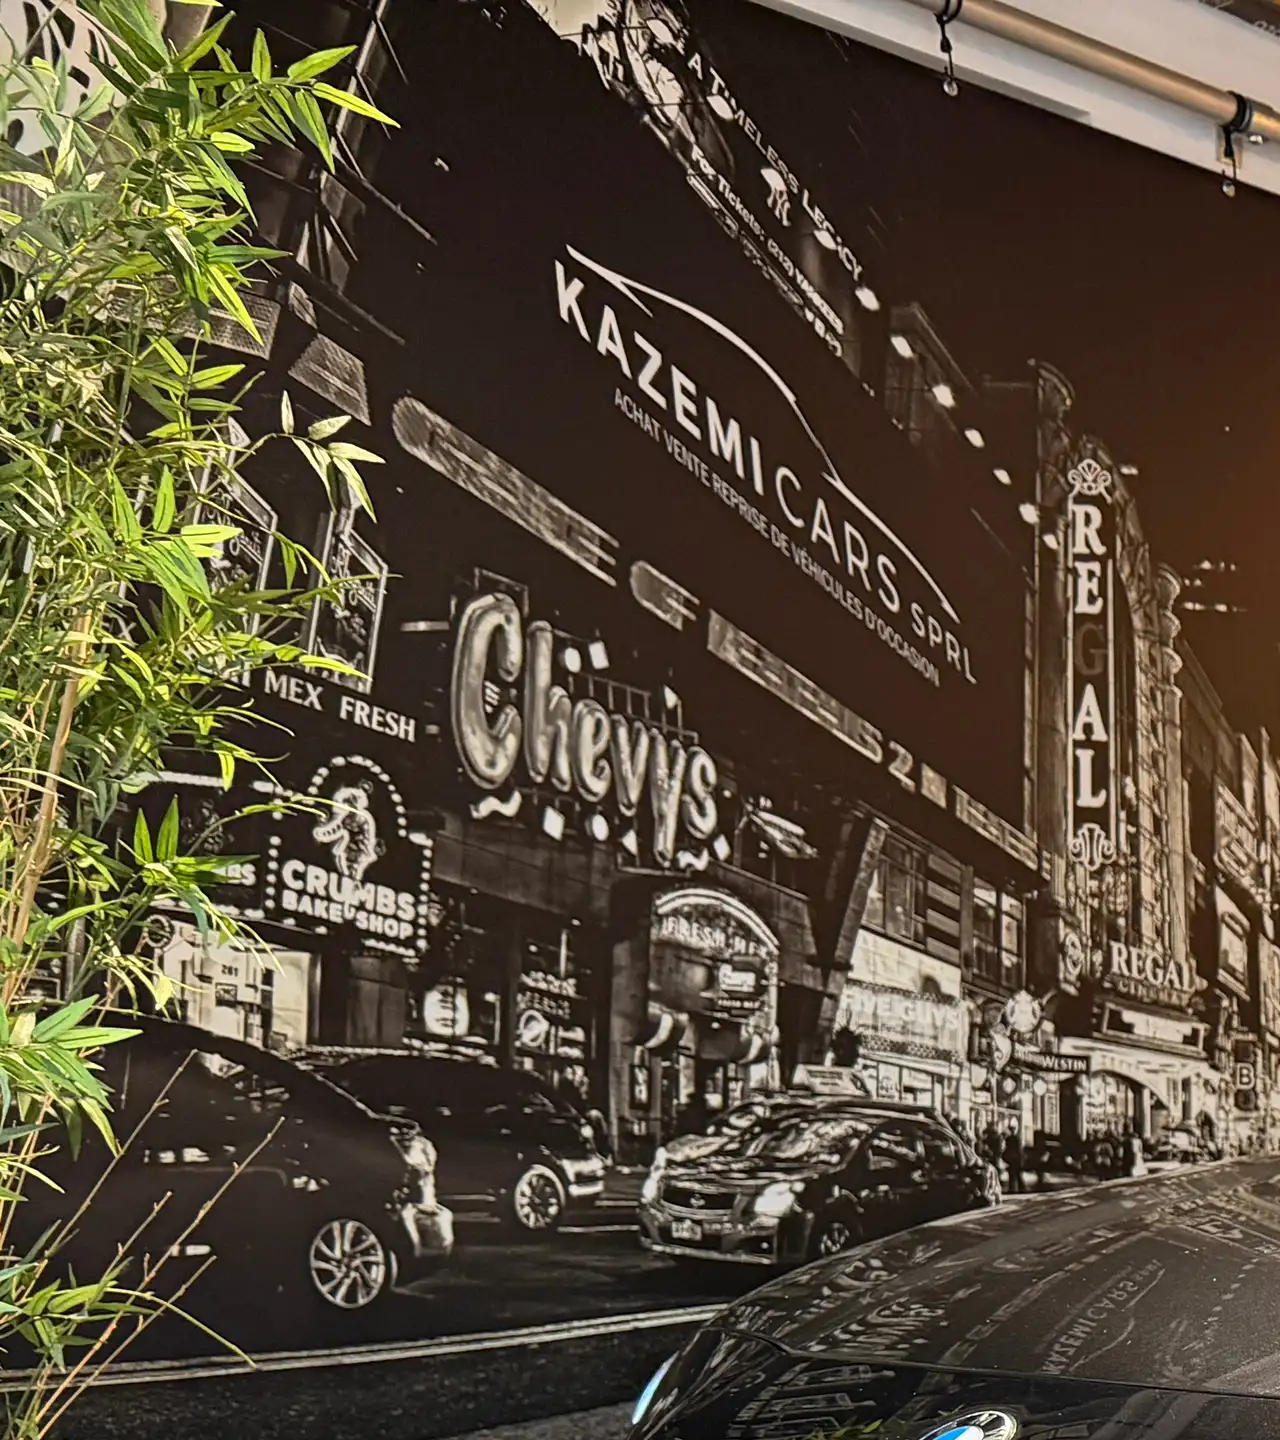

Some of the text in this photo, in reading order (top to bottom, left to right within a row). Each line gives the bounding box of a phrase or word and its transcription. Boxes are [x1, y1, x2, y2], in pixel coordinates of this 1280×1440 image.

[555, 259, 764, 496] KAZEMI
[775, 466, 900, 614] CARS
[910, 602, 978, 685] SPRL
[614, 387, 940, 688] ACHAT VENTE REPRISE DE VÉHICULES D'OCCASION
[264, 668, 323, 711] MEX
[339, 696, 417, 743] FRESH
[451, 591, 718, 868] Chevys
[1072, 503, 1108, 809] REGAL
[281, 892, 412, 941] BAKE SHOP
[282, 859, 416, 922] CRUMBS
[1041, 1054, 1089, 1073] WESTIN
